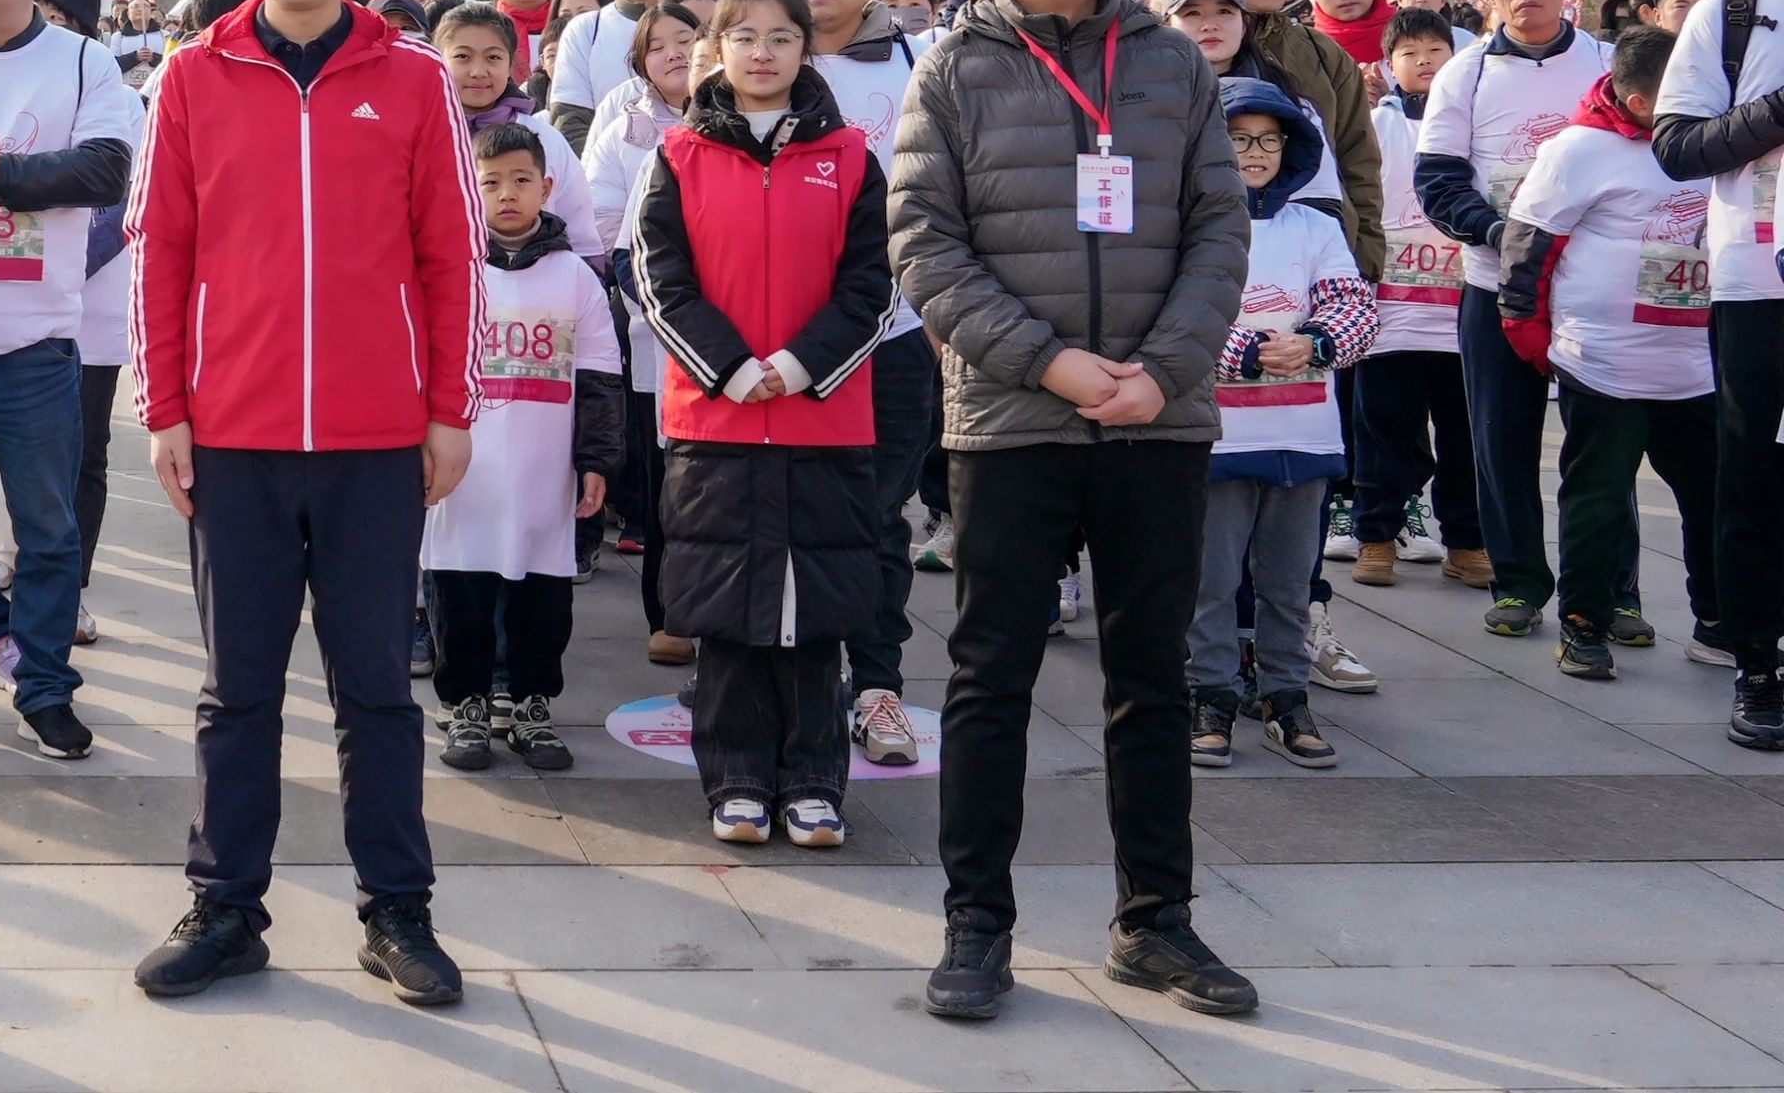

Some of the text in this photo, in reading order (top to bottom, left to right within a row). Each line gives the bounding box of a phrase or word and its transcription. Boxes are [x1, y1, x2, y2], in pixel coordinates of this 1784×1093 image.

[1118, 91, 1145, 102] Jeep
[351, 111, 380, 120] adidas
[1097, 179, 1112, 225] 工作证
[1396, 243, 1461, 273] 407
[484, 321, 554, 360] 408
